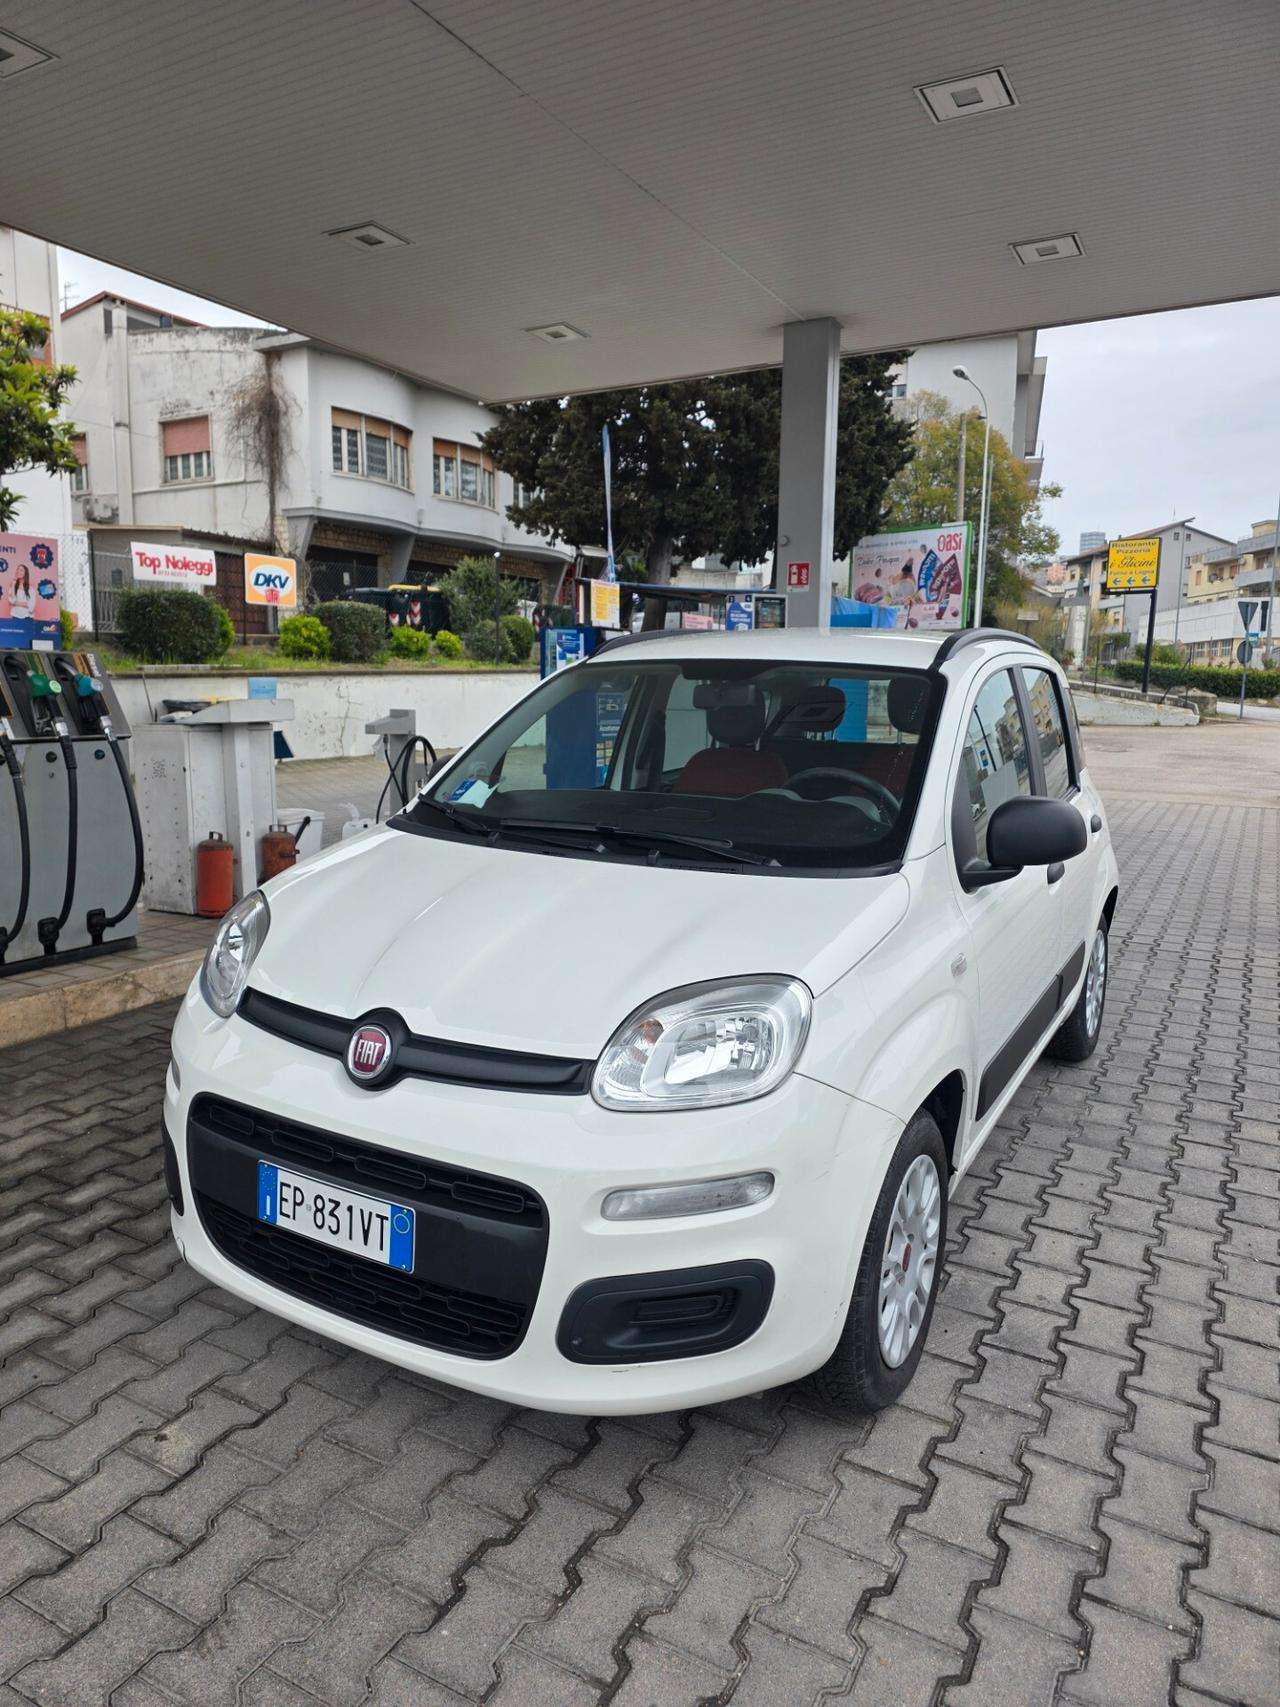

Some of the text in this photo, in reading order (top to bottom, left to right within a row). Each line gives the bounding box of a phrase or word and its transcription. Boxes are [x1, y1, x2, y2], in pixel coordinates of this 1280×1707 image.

[135, 552, 213, 576] Top Noleggi
[253, 572, 289, 589] DKV
[355, 1038, 382, 1066] FIAT
